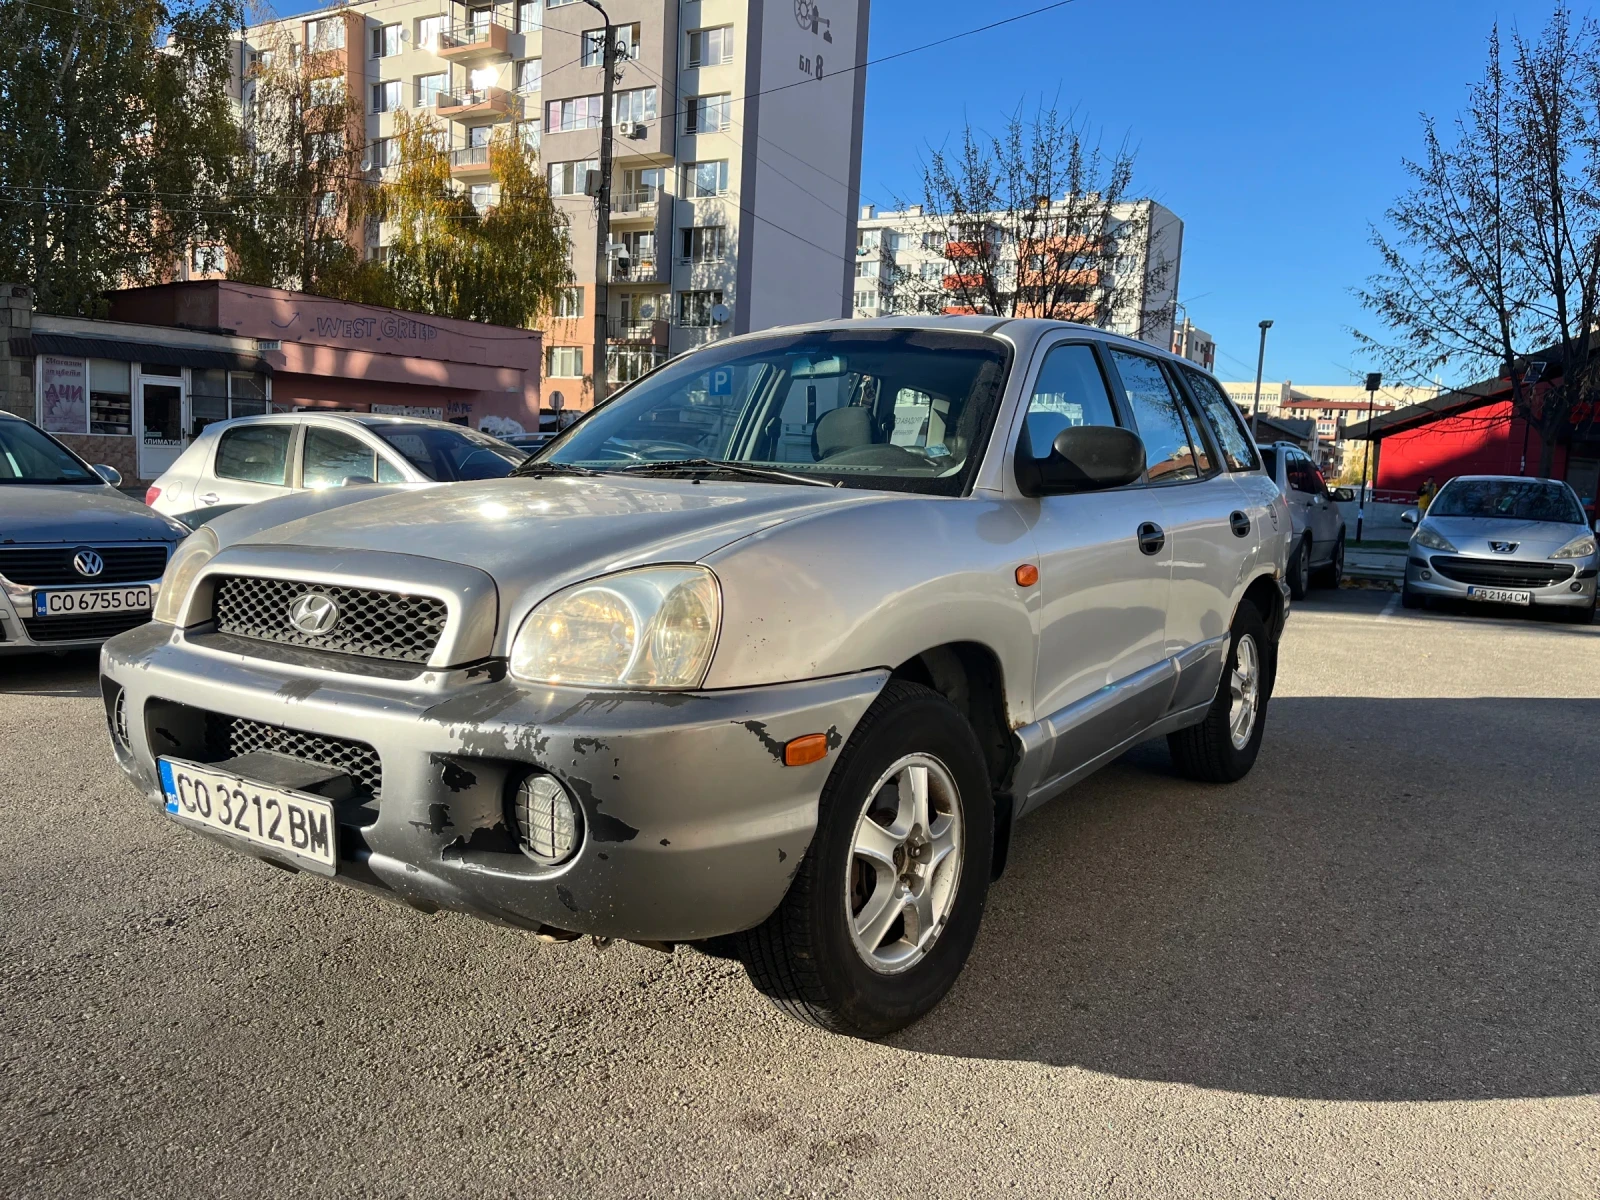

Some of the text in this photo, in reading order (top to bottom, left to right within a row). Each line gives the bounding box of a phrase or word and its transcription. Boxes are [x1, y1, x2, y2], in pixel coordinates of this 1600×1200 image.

[816, 54, 824, 81] 8
[317, 317, 376, 338] WEST
[45, 357, 82, 368] Магазин
[714, 371, 728, 393] P
[50, 594, 75, 612] CO
[79, 592, 122, 610] 6755
[125, 590, 147, 607] CC
[1489, 590, 1513, 602] 2184
[1515, 593, 1529, 603] CM
[166, 773, 330, 857] BG CO 3212 BM
